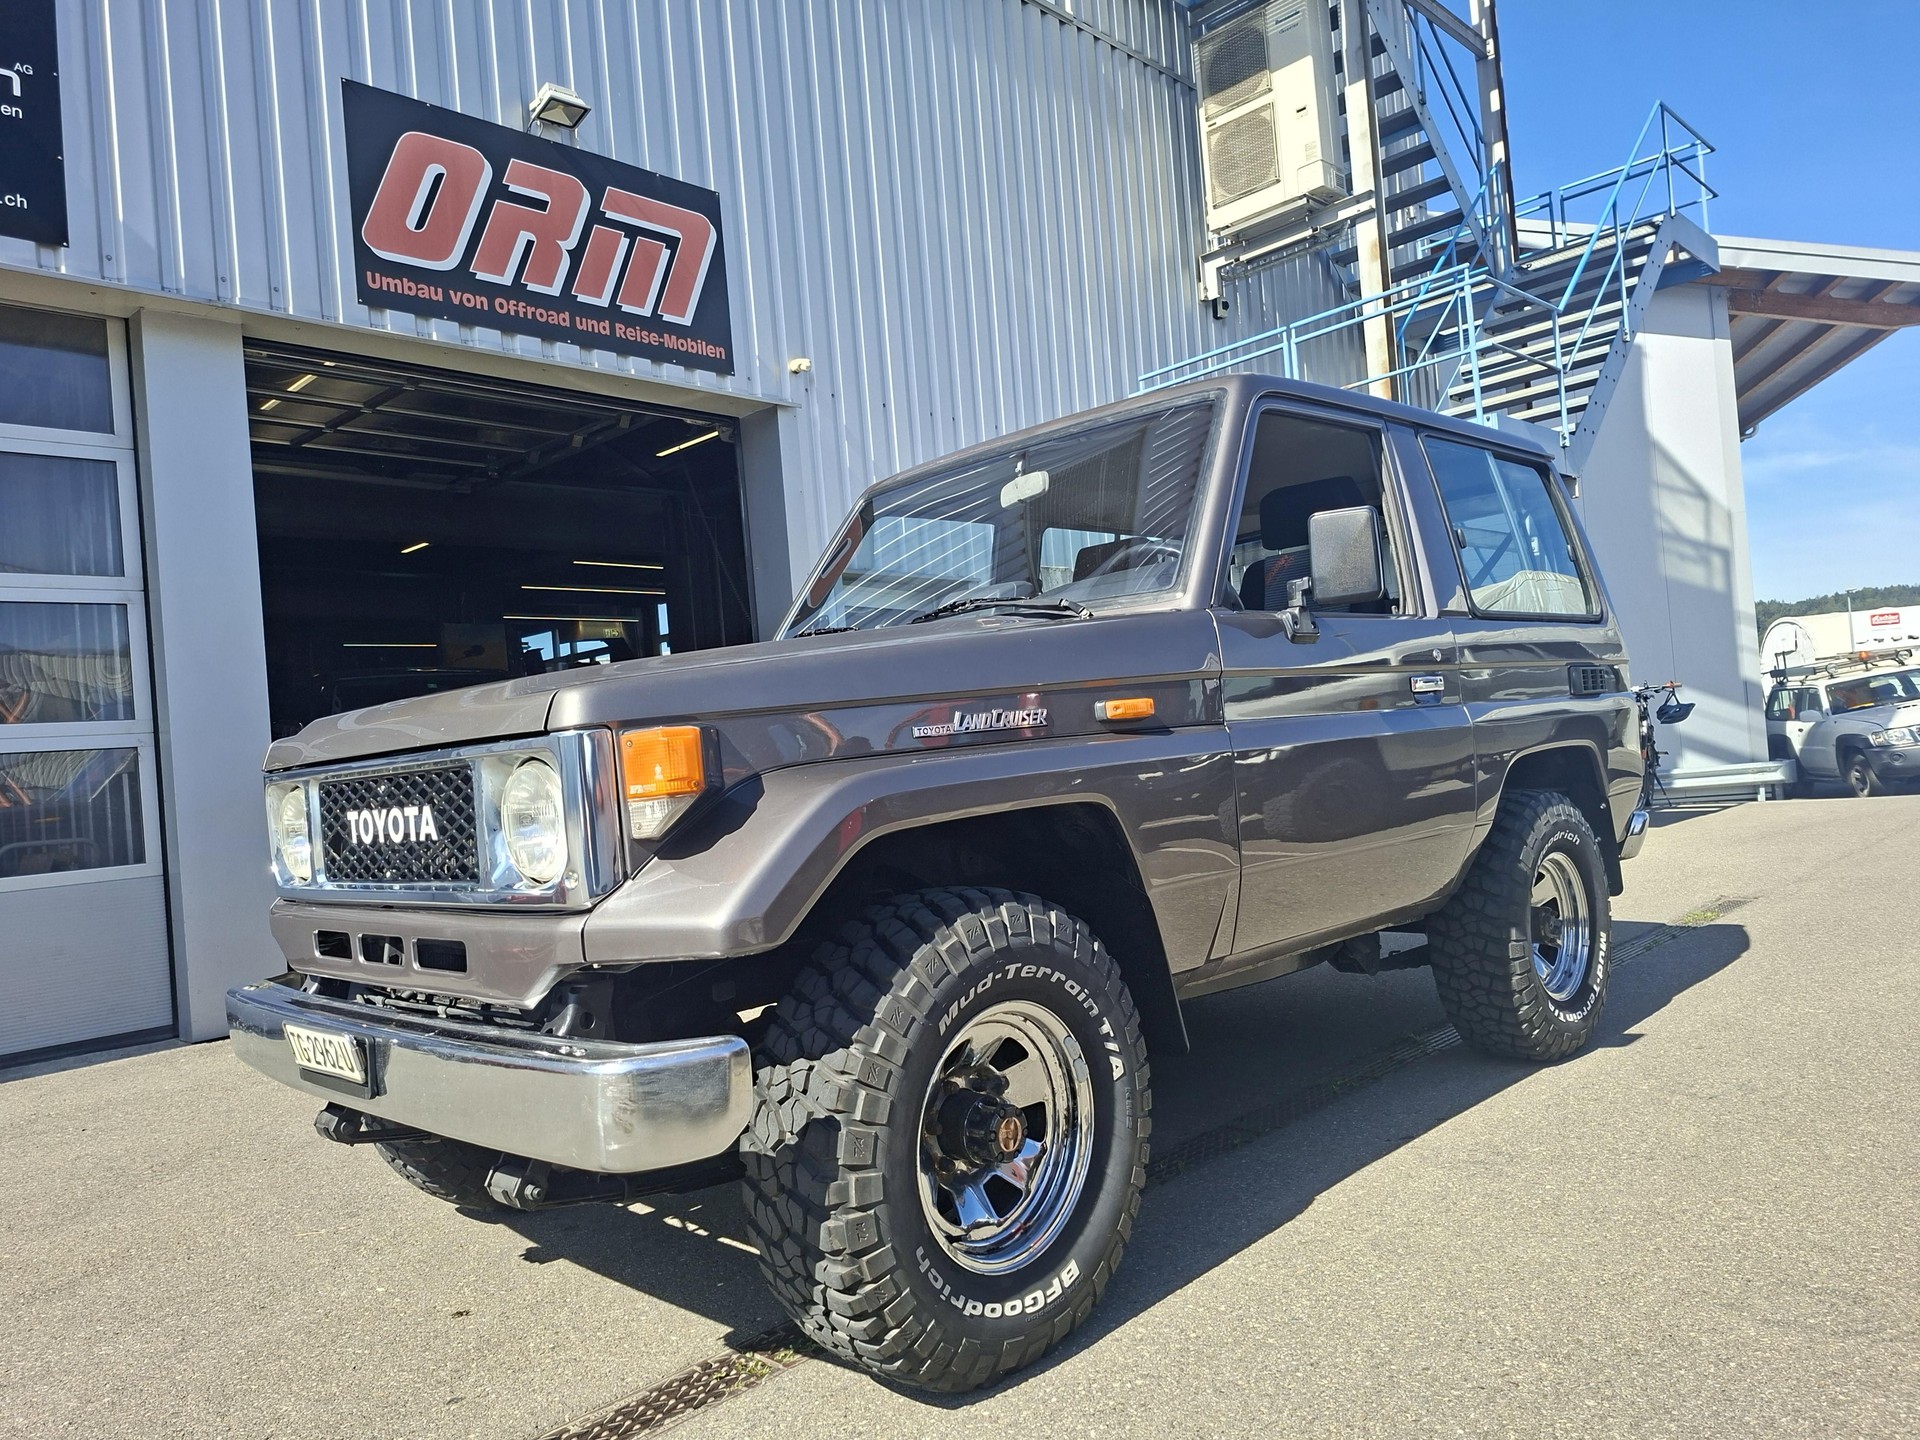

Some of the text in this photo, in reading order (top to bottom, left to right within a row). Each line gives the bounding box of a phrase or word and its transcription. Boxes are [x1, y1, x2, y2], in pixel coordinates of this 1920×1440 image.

[13, 62, 33, 76] AG
[362, 131, 717, 326] ORM
[366, 271, 726, 360] Umbau von Offroad und Reise-Mobilen
[917, 725, 951, 736] TOYOTA
[347, 805, 439, 845] TOYOTA
[938, 962, 1100, 1036] Mud-Terrain
[915, 1246, 1081, 1319] BFGoodrich
